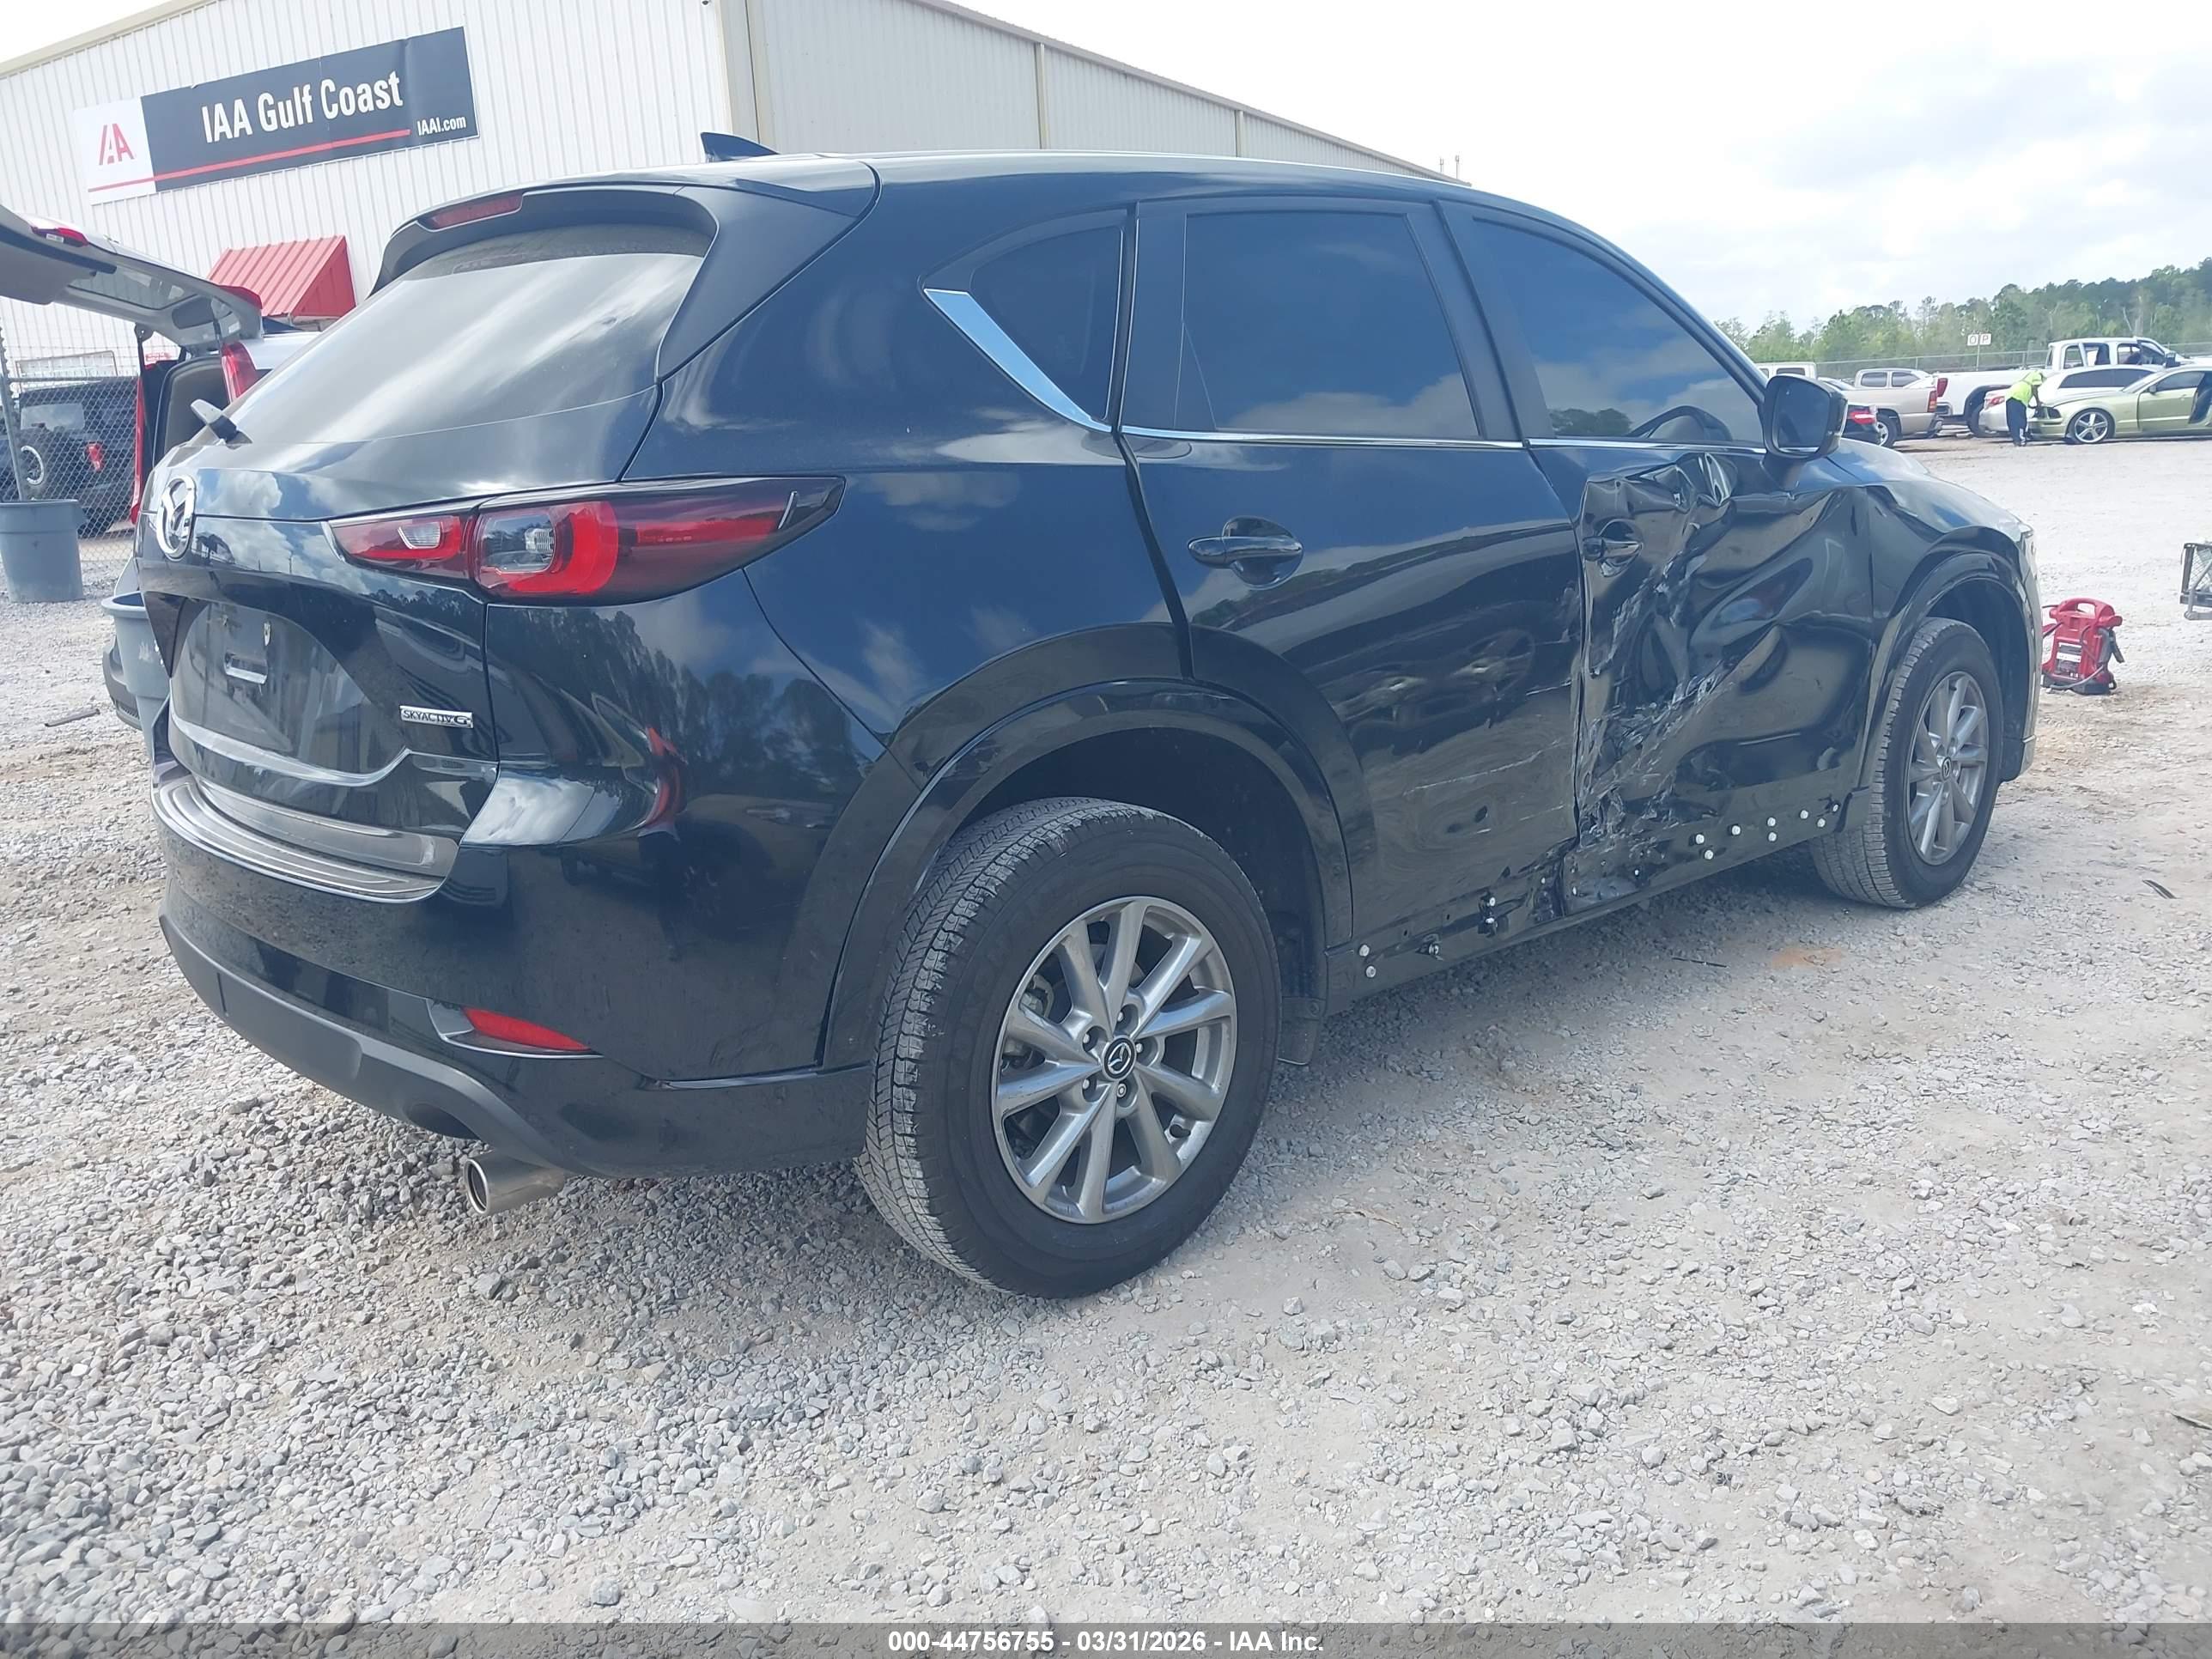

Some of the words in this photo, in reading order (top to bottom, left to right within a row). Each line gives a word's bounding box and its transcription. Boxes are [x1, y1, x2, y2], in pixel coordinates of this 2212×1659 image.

[201, 99, 253, 144] IAA
[257, 82, 314, 132] Gulf
[320, 70, 404, 120] Coast
[416, 115, 466, 137] IAAI.com
